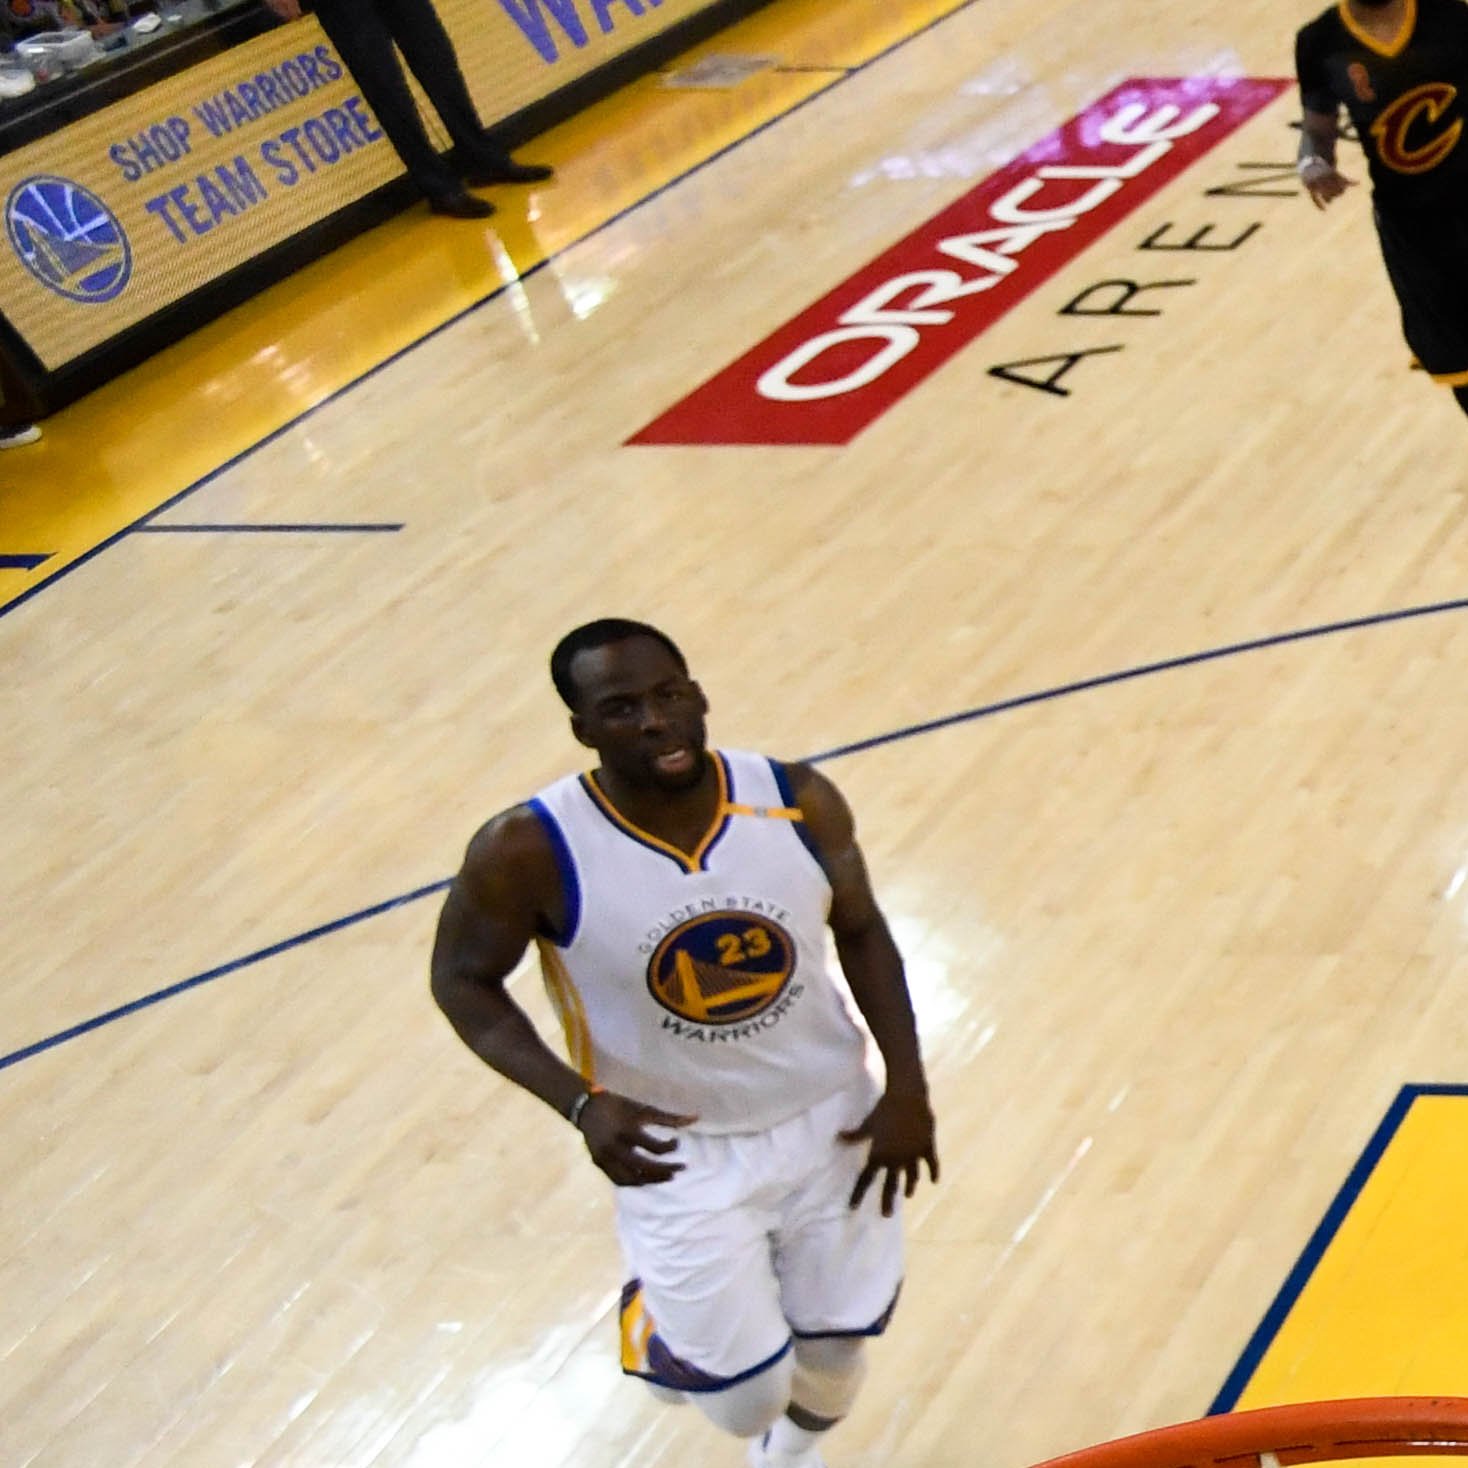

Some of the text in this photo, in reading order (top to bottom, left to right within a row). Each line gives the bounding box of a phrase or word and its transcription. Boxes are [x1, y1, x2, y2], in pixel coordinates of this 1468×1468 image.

[109, 45, 343, 182] SHOP WARRIORS
[1369, 82, 1464, 175] C
[145, 95, 383, 244] TEAM STORE
[756, 104, 1220, 400] ORACLE
[638, 896, 792, 955] GOLDEN STATE
[716, 927, 772, 967] 23
[661, 982, 806, 1043] WARRIORS
